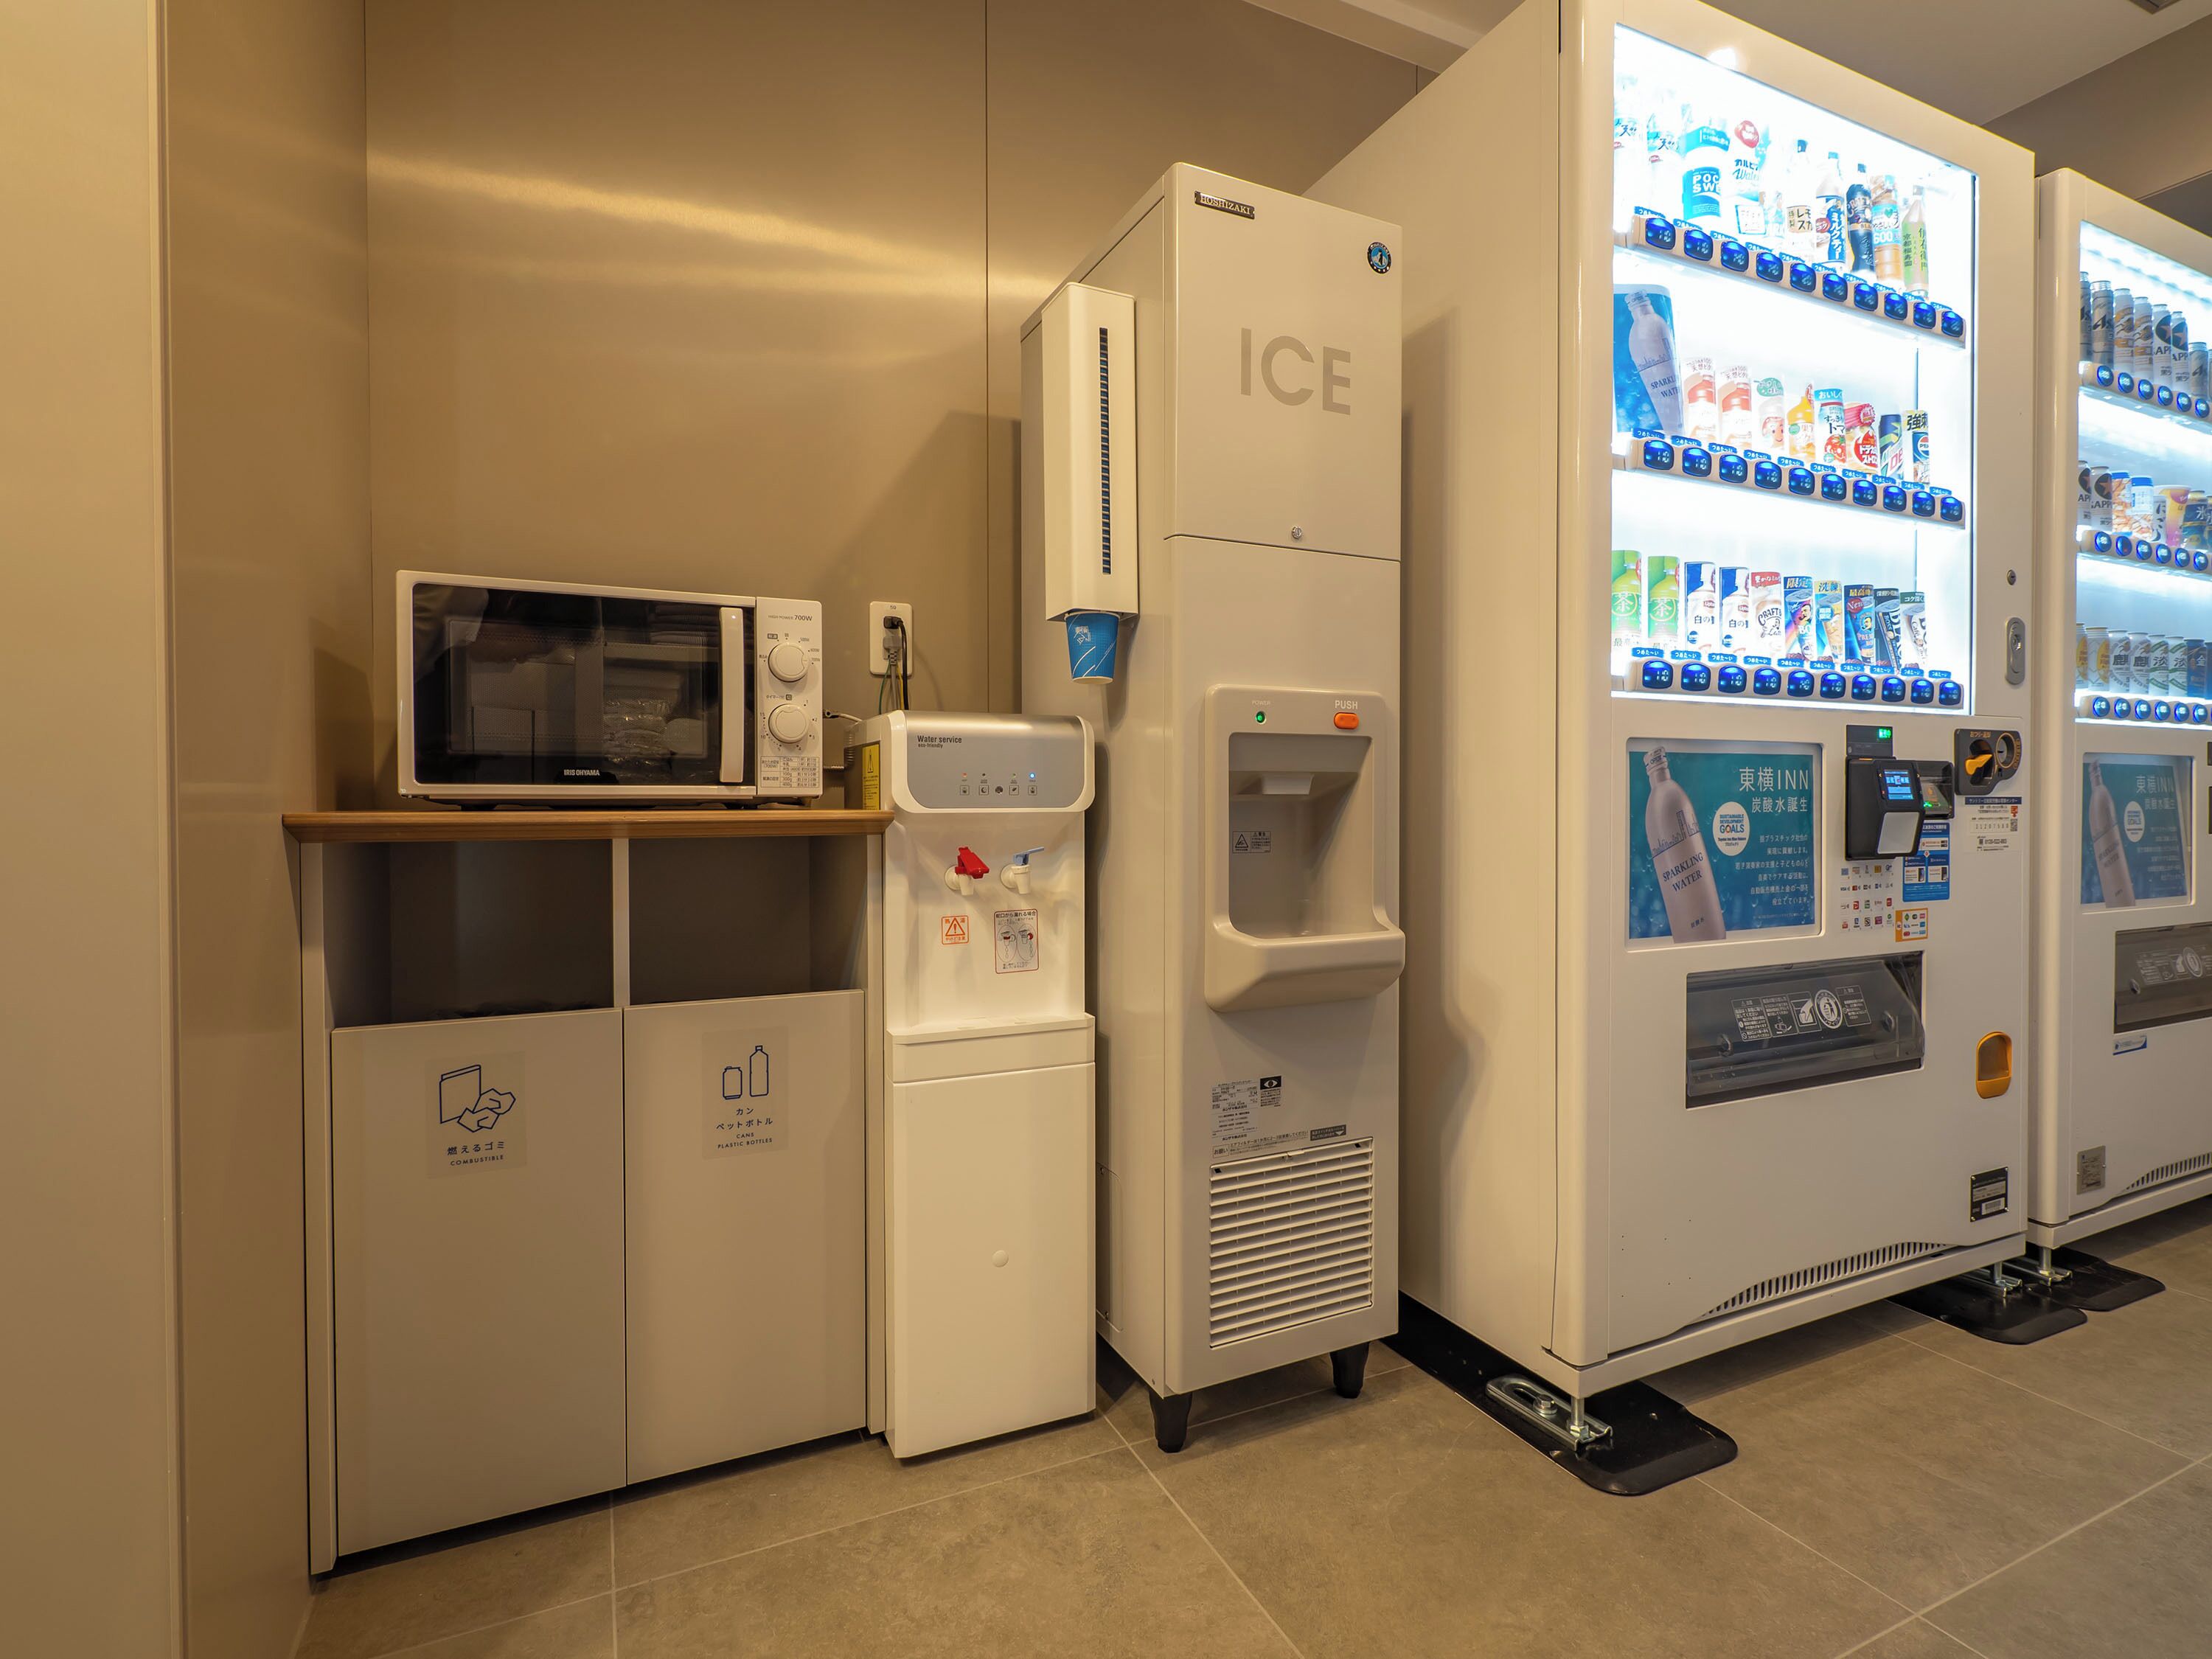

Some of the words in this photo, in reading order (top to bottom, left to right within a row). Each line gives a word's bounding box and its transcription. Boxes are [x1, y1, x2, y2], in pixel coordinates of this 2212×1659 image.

[1200, 195, 1251, 215] HOSHIZAKI
[1873, 231, 1893, 244] 600
[1240, 327, 1352, 415] ICE
[1334, 700, 1359, 710] PUSH
[917, 735, 937, 743] Water
[939, 736, 962, 744] service
[1739, 766, 1809, 792] 東横INN
[1751, 796, 1809, 813] 炭酸水誕生
[1719, 824, 1745, 835] GOALS
[1663, 852, 1704, 882] SPARKLING
[1672, 869, 1703, 892] WATER
[736, 1107, 754, 1116] カン
[716, 1117, 773, 1131] ペットボトル
[447, 1141, 505, 1156] 燃えるゴミ
[717, 1141, 743, 1150] PLASTIC
[746, 1137, 773, 1146] BOTTLES
[450, 1154, 504, 1166] COMBUSTIBLE
